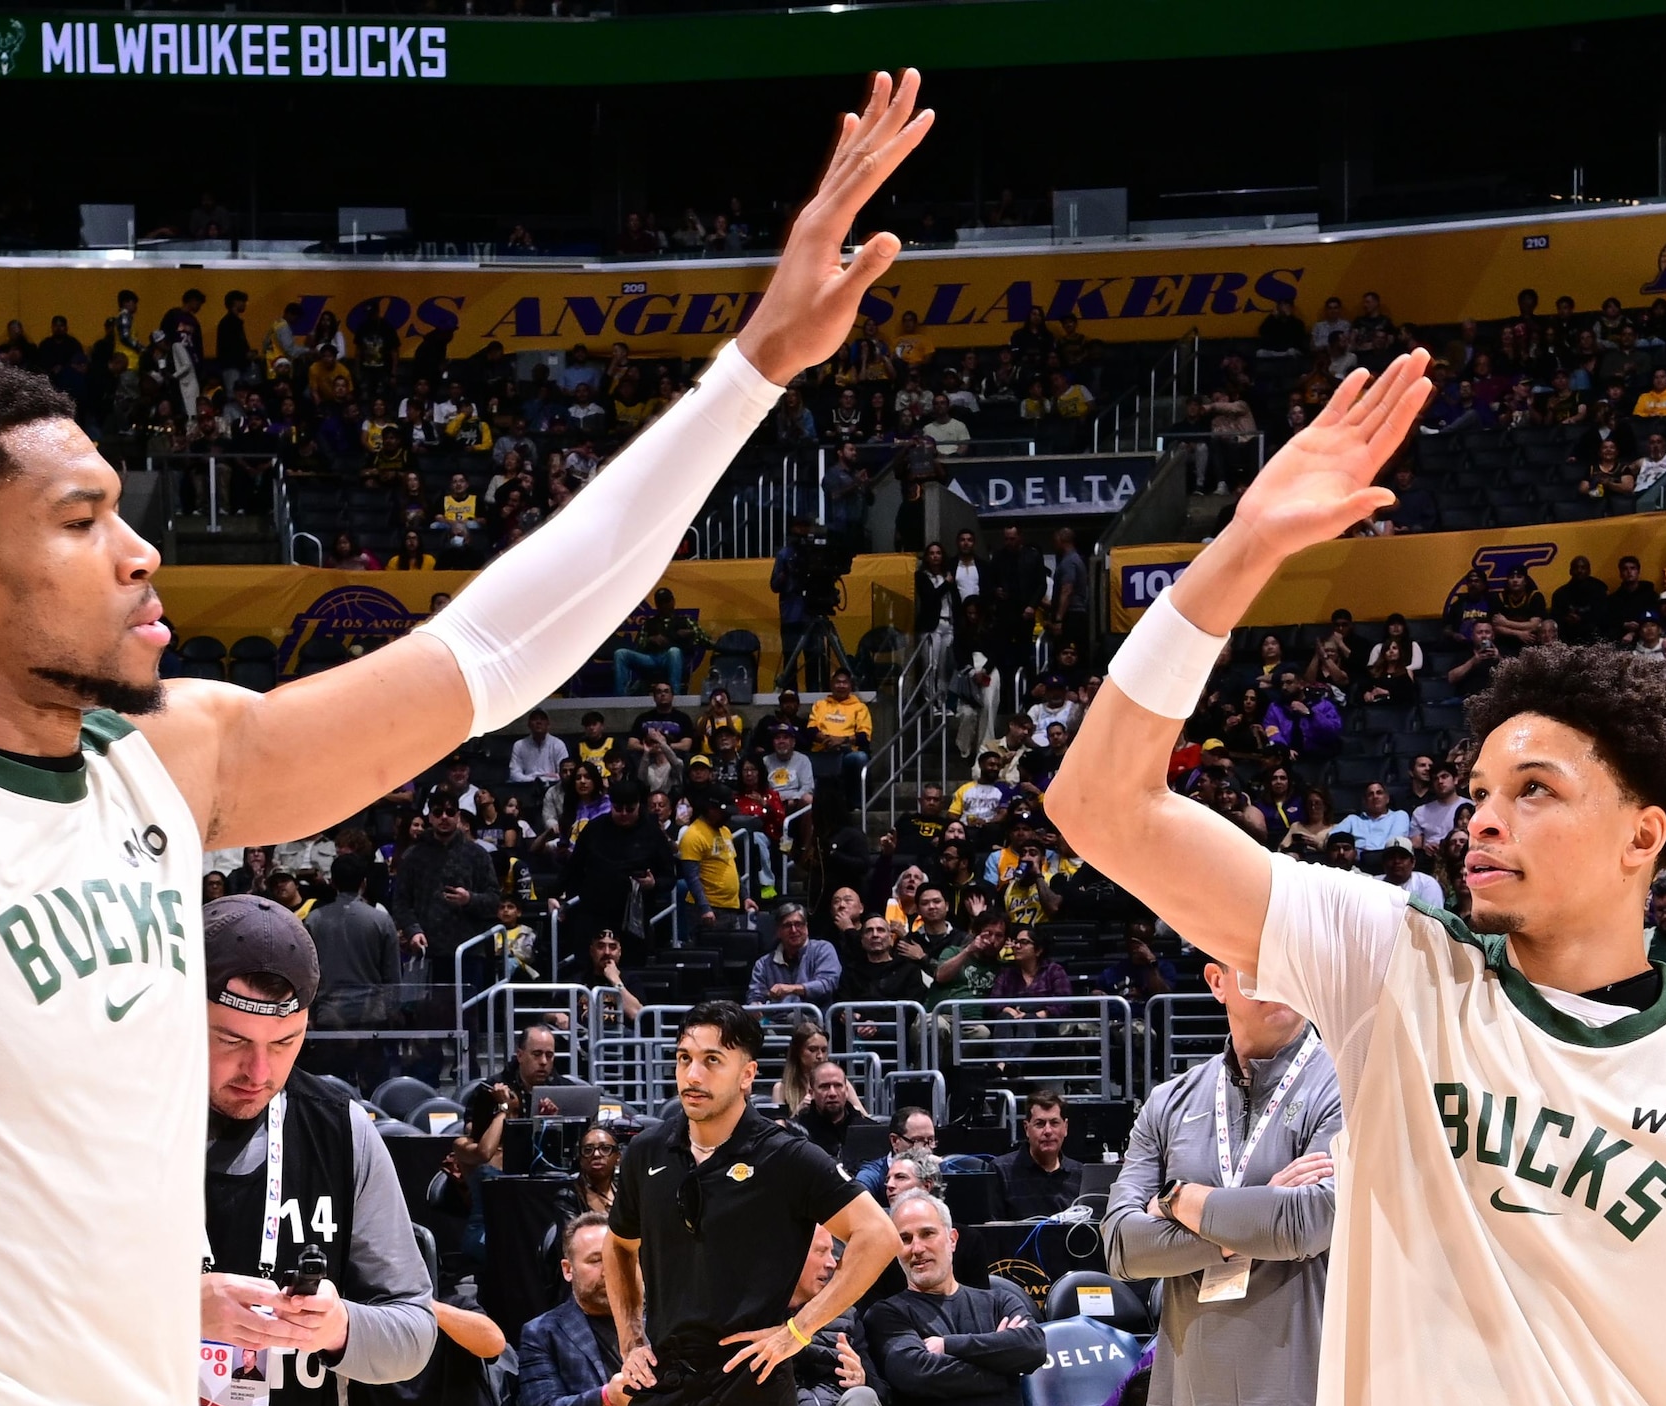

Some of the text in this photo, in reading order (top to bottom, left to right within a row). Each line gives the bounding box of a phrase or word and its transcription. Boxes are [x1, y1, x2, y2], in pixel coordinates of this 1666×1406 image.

[42, 22, 446, 78] MILWAUKEE BUCKS
[1525, 237, 1547, 249] 210
[623, 283, 646, 293] 209
[918, 268, 1305, 326] LAKERS
[988, 474, 1136, 506] DELTA
[333, 618, 363, 630] LOS
[1041, 1342, 1125, 1370] DELTA
